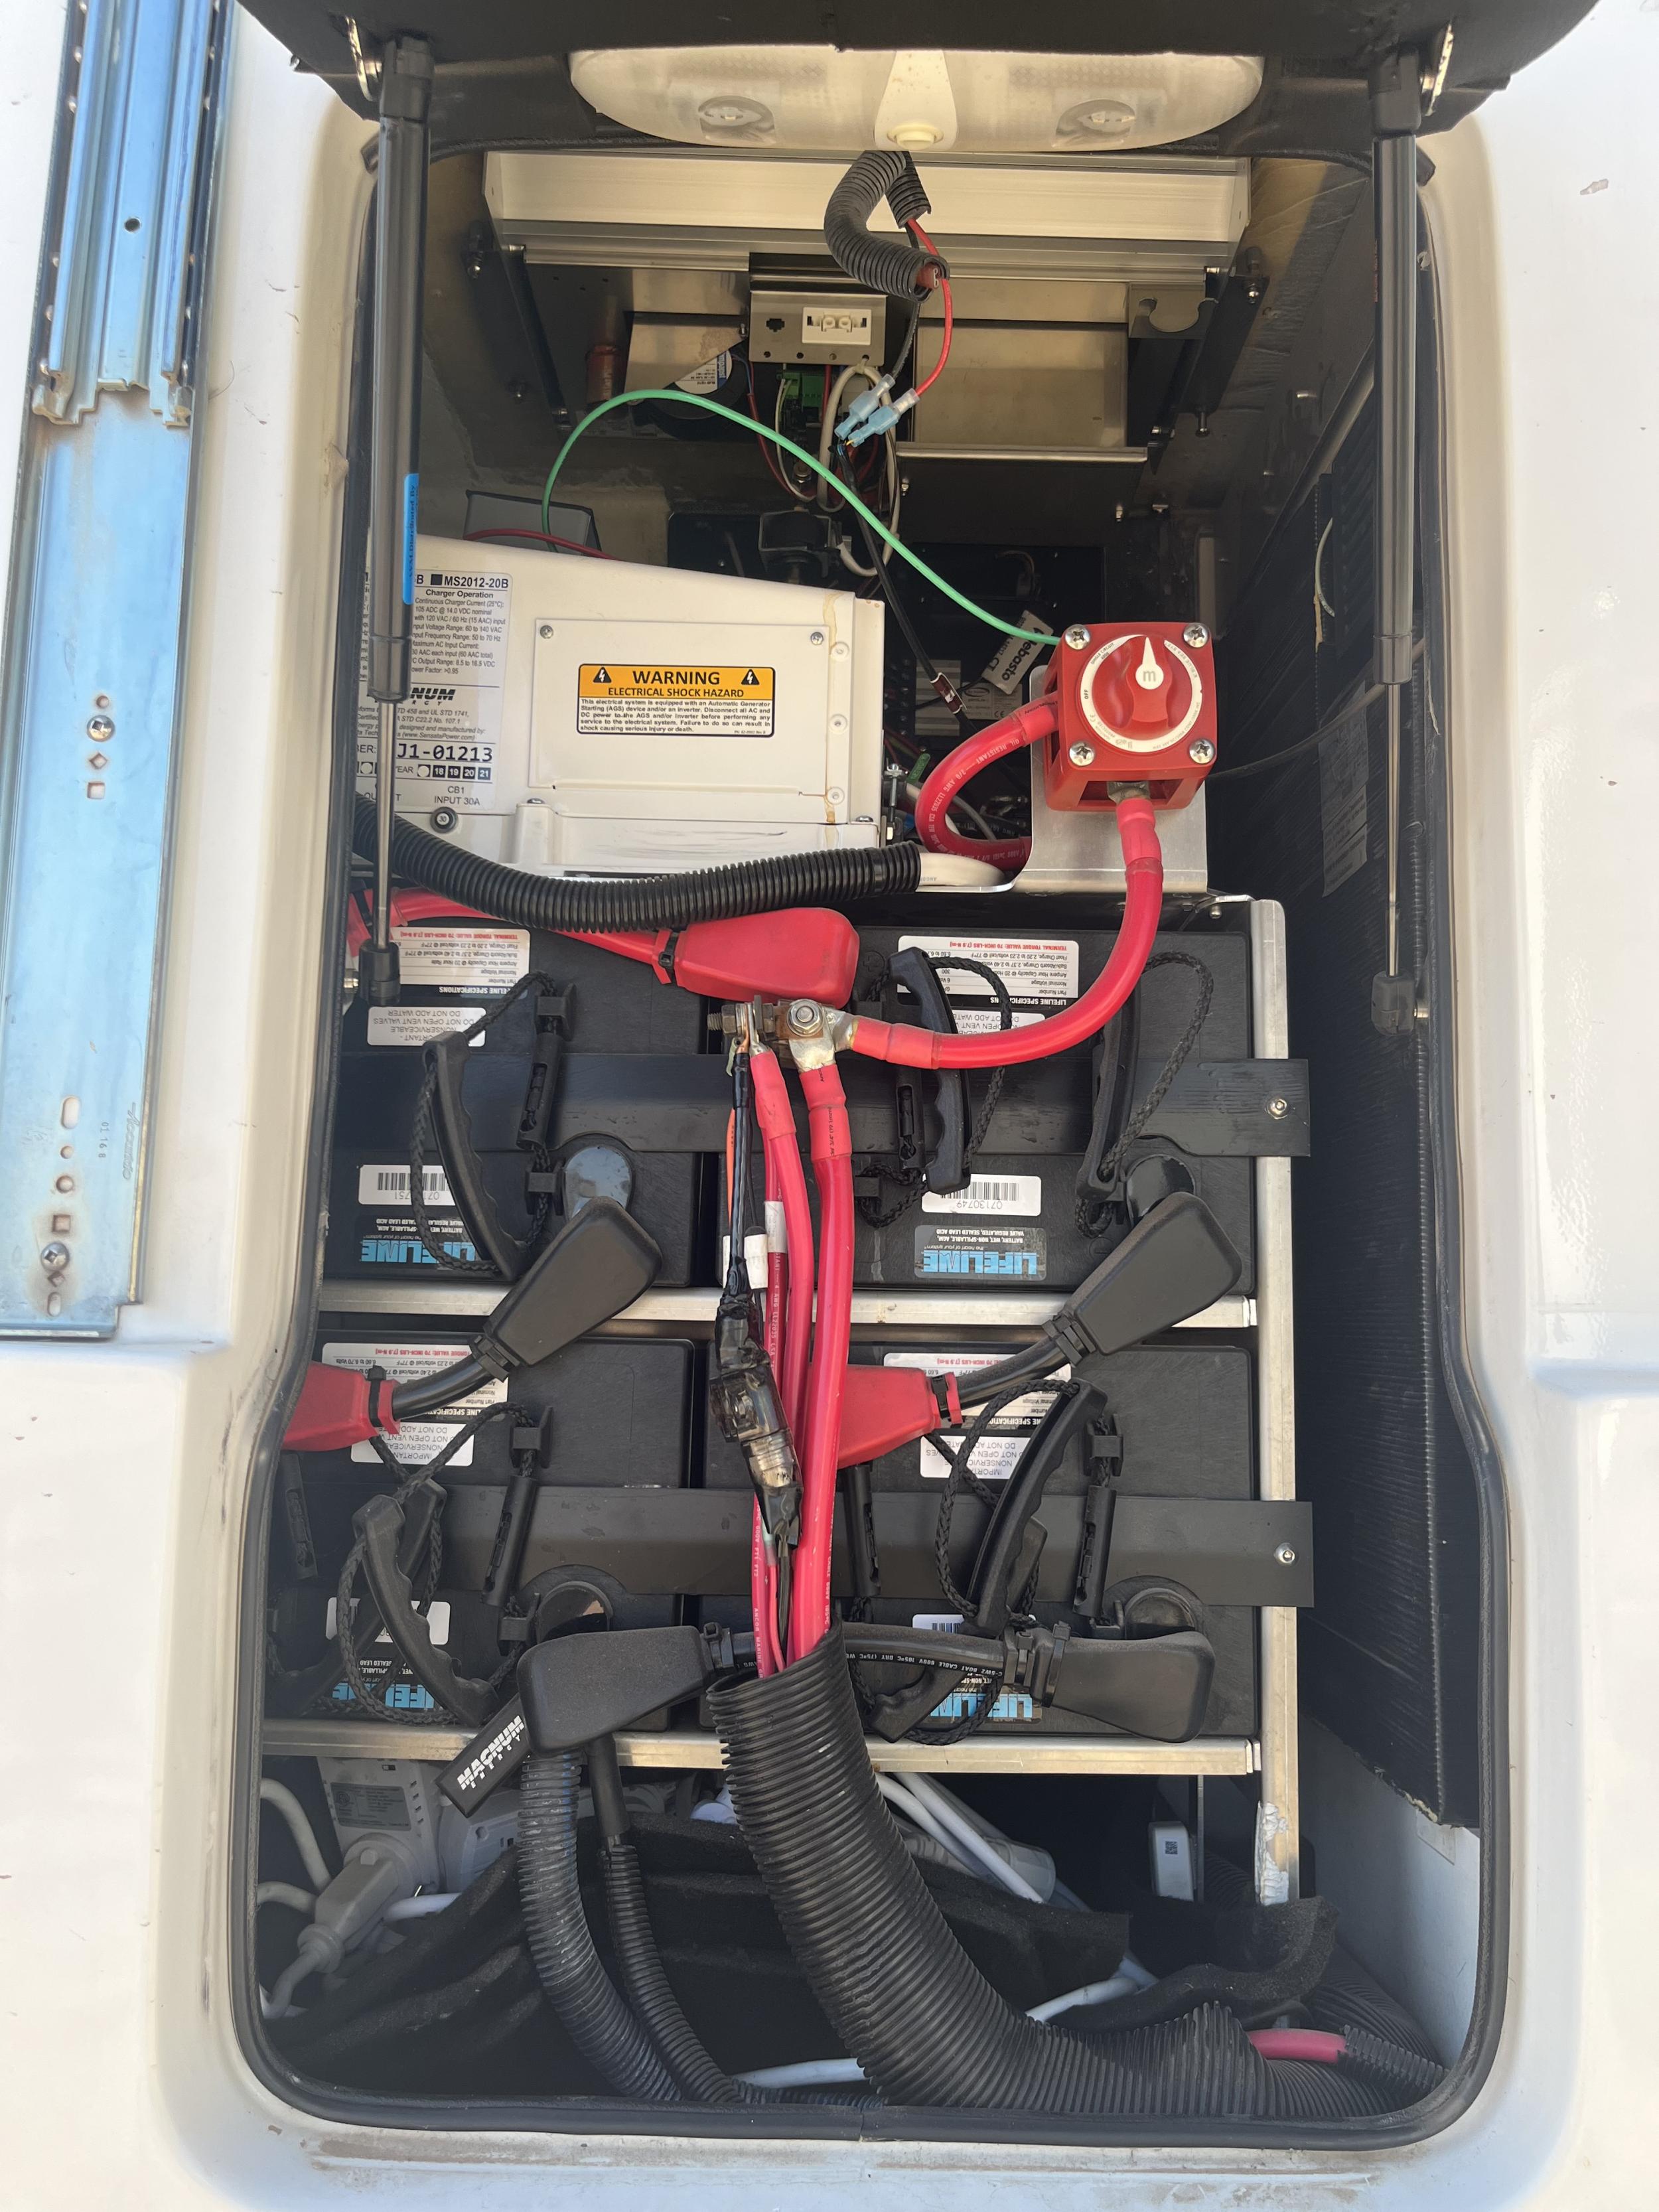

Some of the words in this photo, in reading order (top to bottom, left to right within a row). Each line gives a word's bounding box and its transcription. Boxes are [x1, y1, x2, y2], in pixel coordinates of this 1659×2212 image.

[445, 576, 508, 588] MS2012-20B
[632, 670, 720, 685] WARNING
[410, 688, 456, 700] NUM
[609, 688, 664, 696] ELECTRICAL
[703, 689, 744, 698] HAZARD
[397, 743, 492, 762] J1-01213
[975, 743, 1007, 765] RESISTANT
[955, 769, 966, 779] 2/0
[943, 778, 955, 792] AWG
[956, 1201, 1003, 1209] 07130749
[923, 1250, 1037, 1275] LIFELINE
[457, 1715, 525, 1791] MAGNUM
